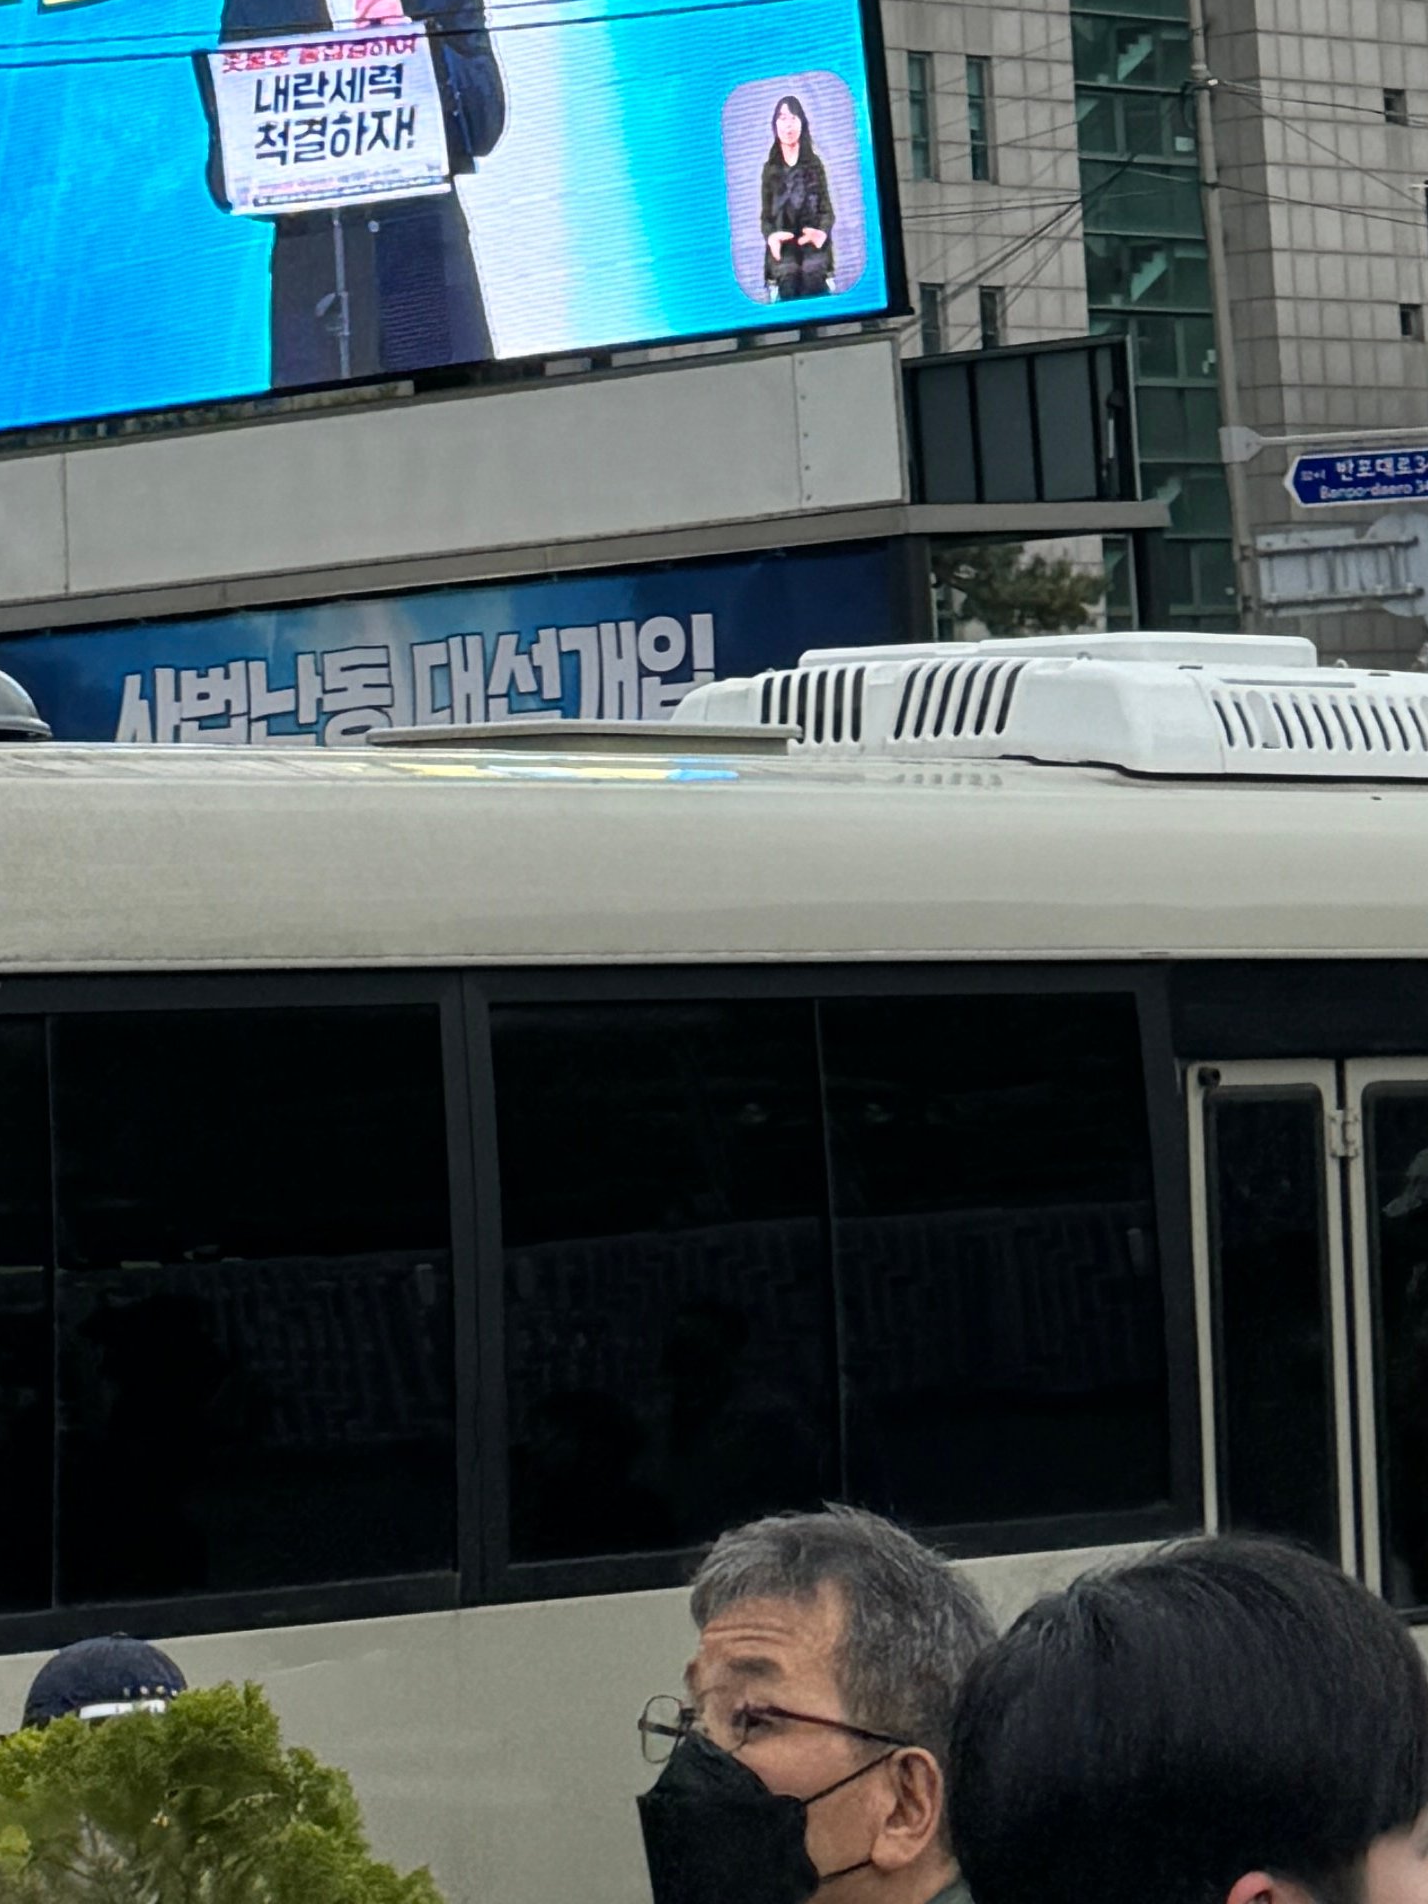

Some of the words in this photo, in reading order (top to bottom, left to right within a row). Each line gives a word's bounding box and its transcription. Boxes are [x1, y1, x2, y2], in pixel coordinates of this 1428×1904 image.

[254, 63, 404, 114] 내란세력
[254, 105, 415, 166] 척결하자!
[114, 645, 395, 746] 사법난동
[411, 612, 715, 726] 대선개입
